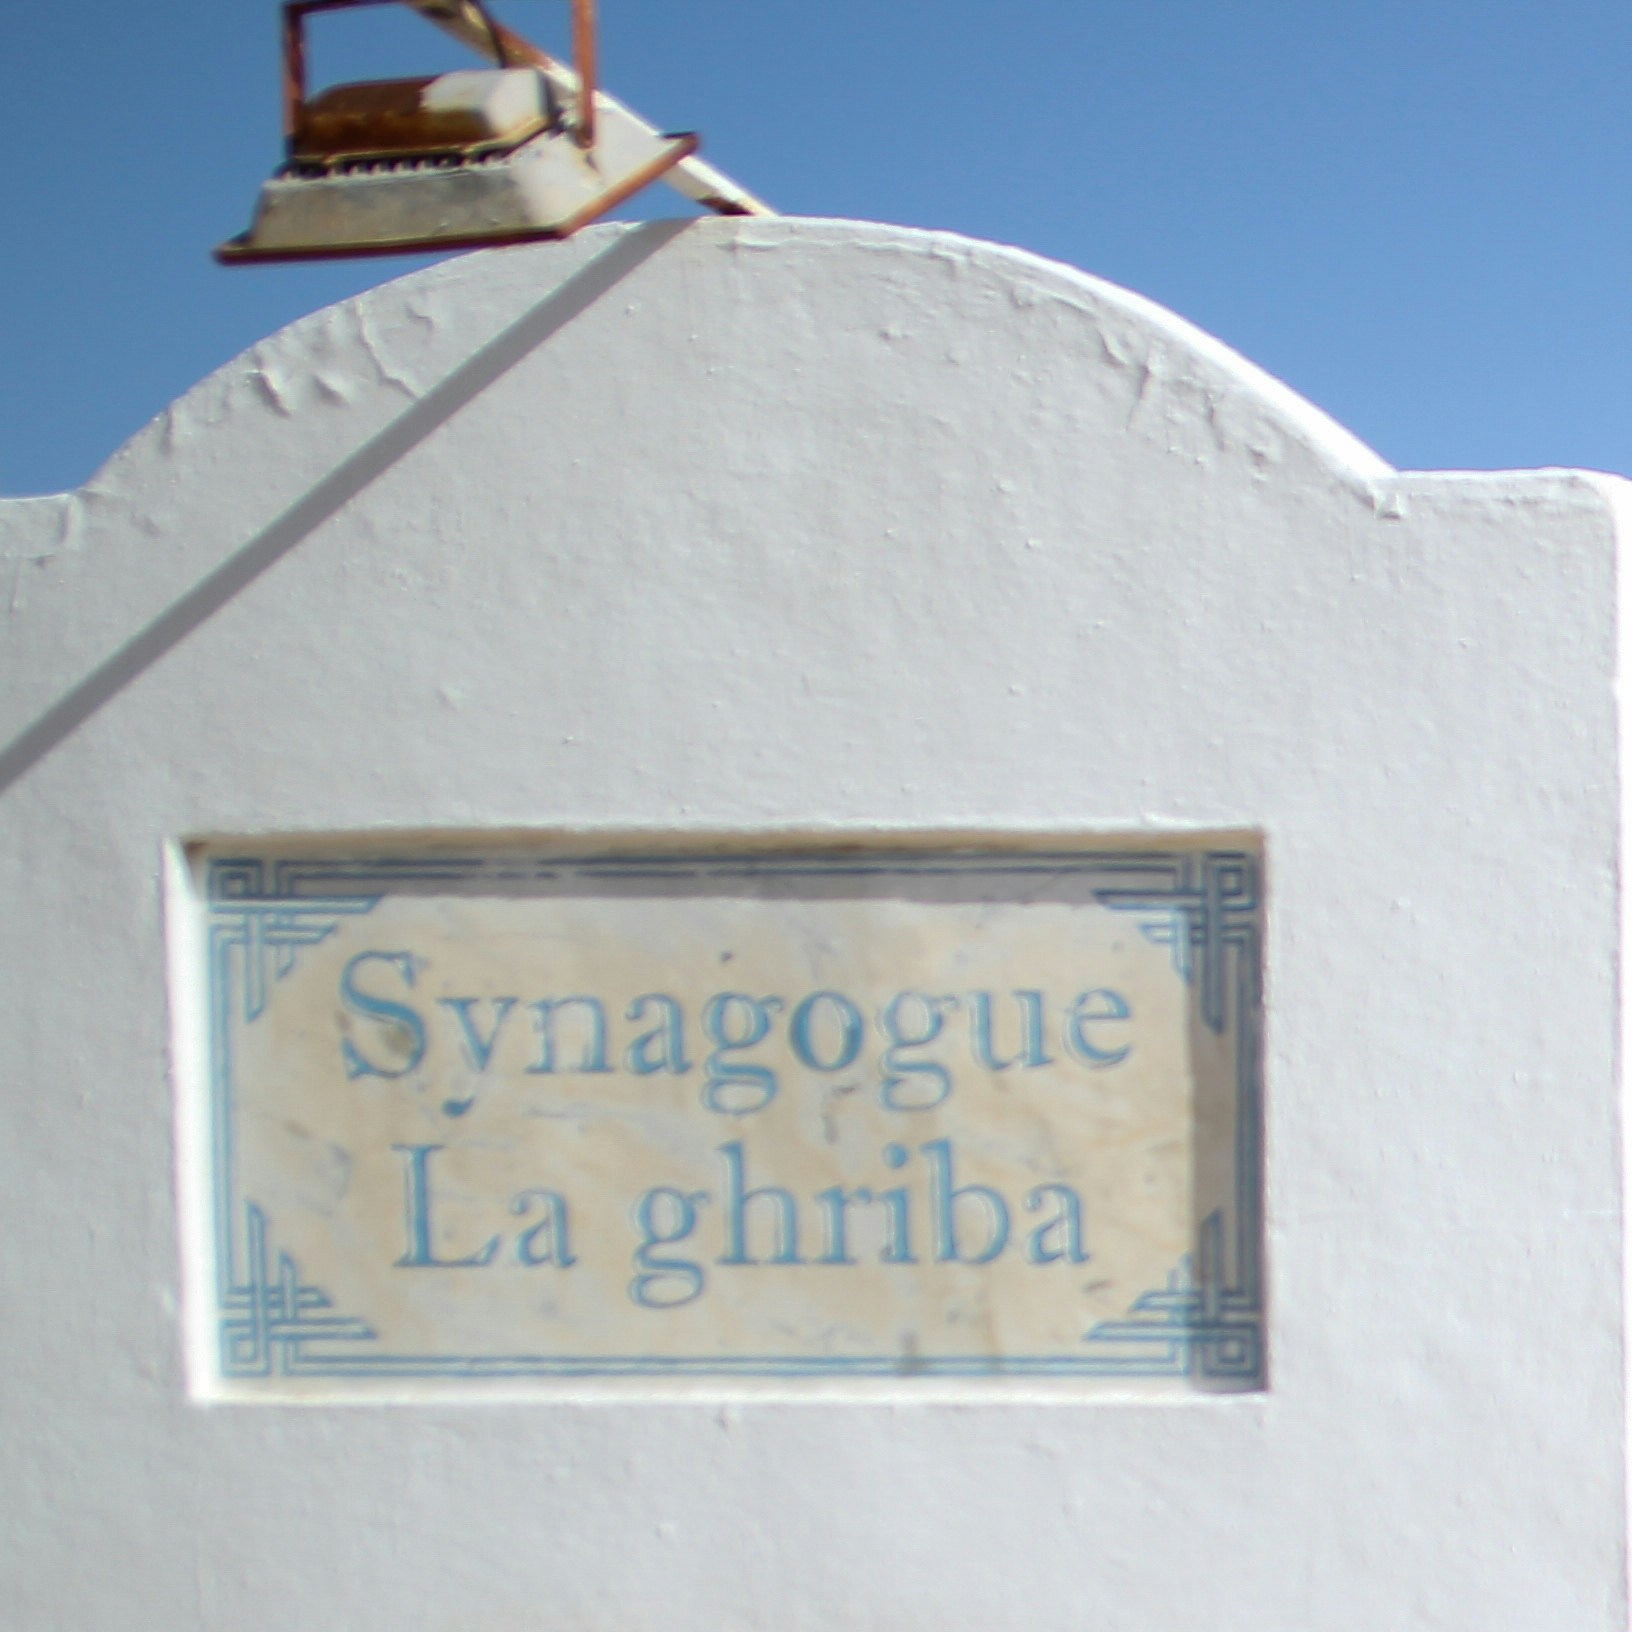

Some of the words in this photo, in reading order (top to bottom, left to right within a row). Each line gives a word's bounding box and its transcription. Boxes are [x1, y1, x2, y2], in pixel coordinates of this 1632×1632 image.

[337, 950, 1132, 1118] Synagogue
[392, 1143, 577, 1270] La
[627, 1139, 1091, 1310] ghriba
